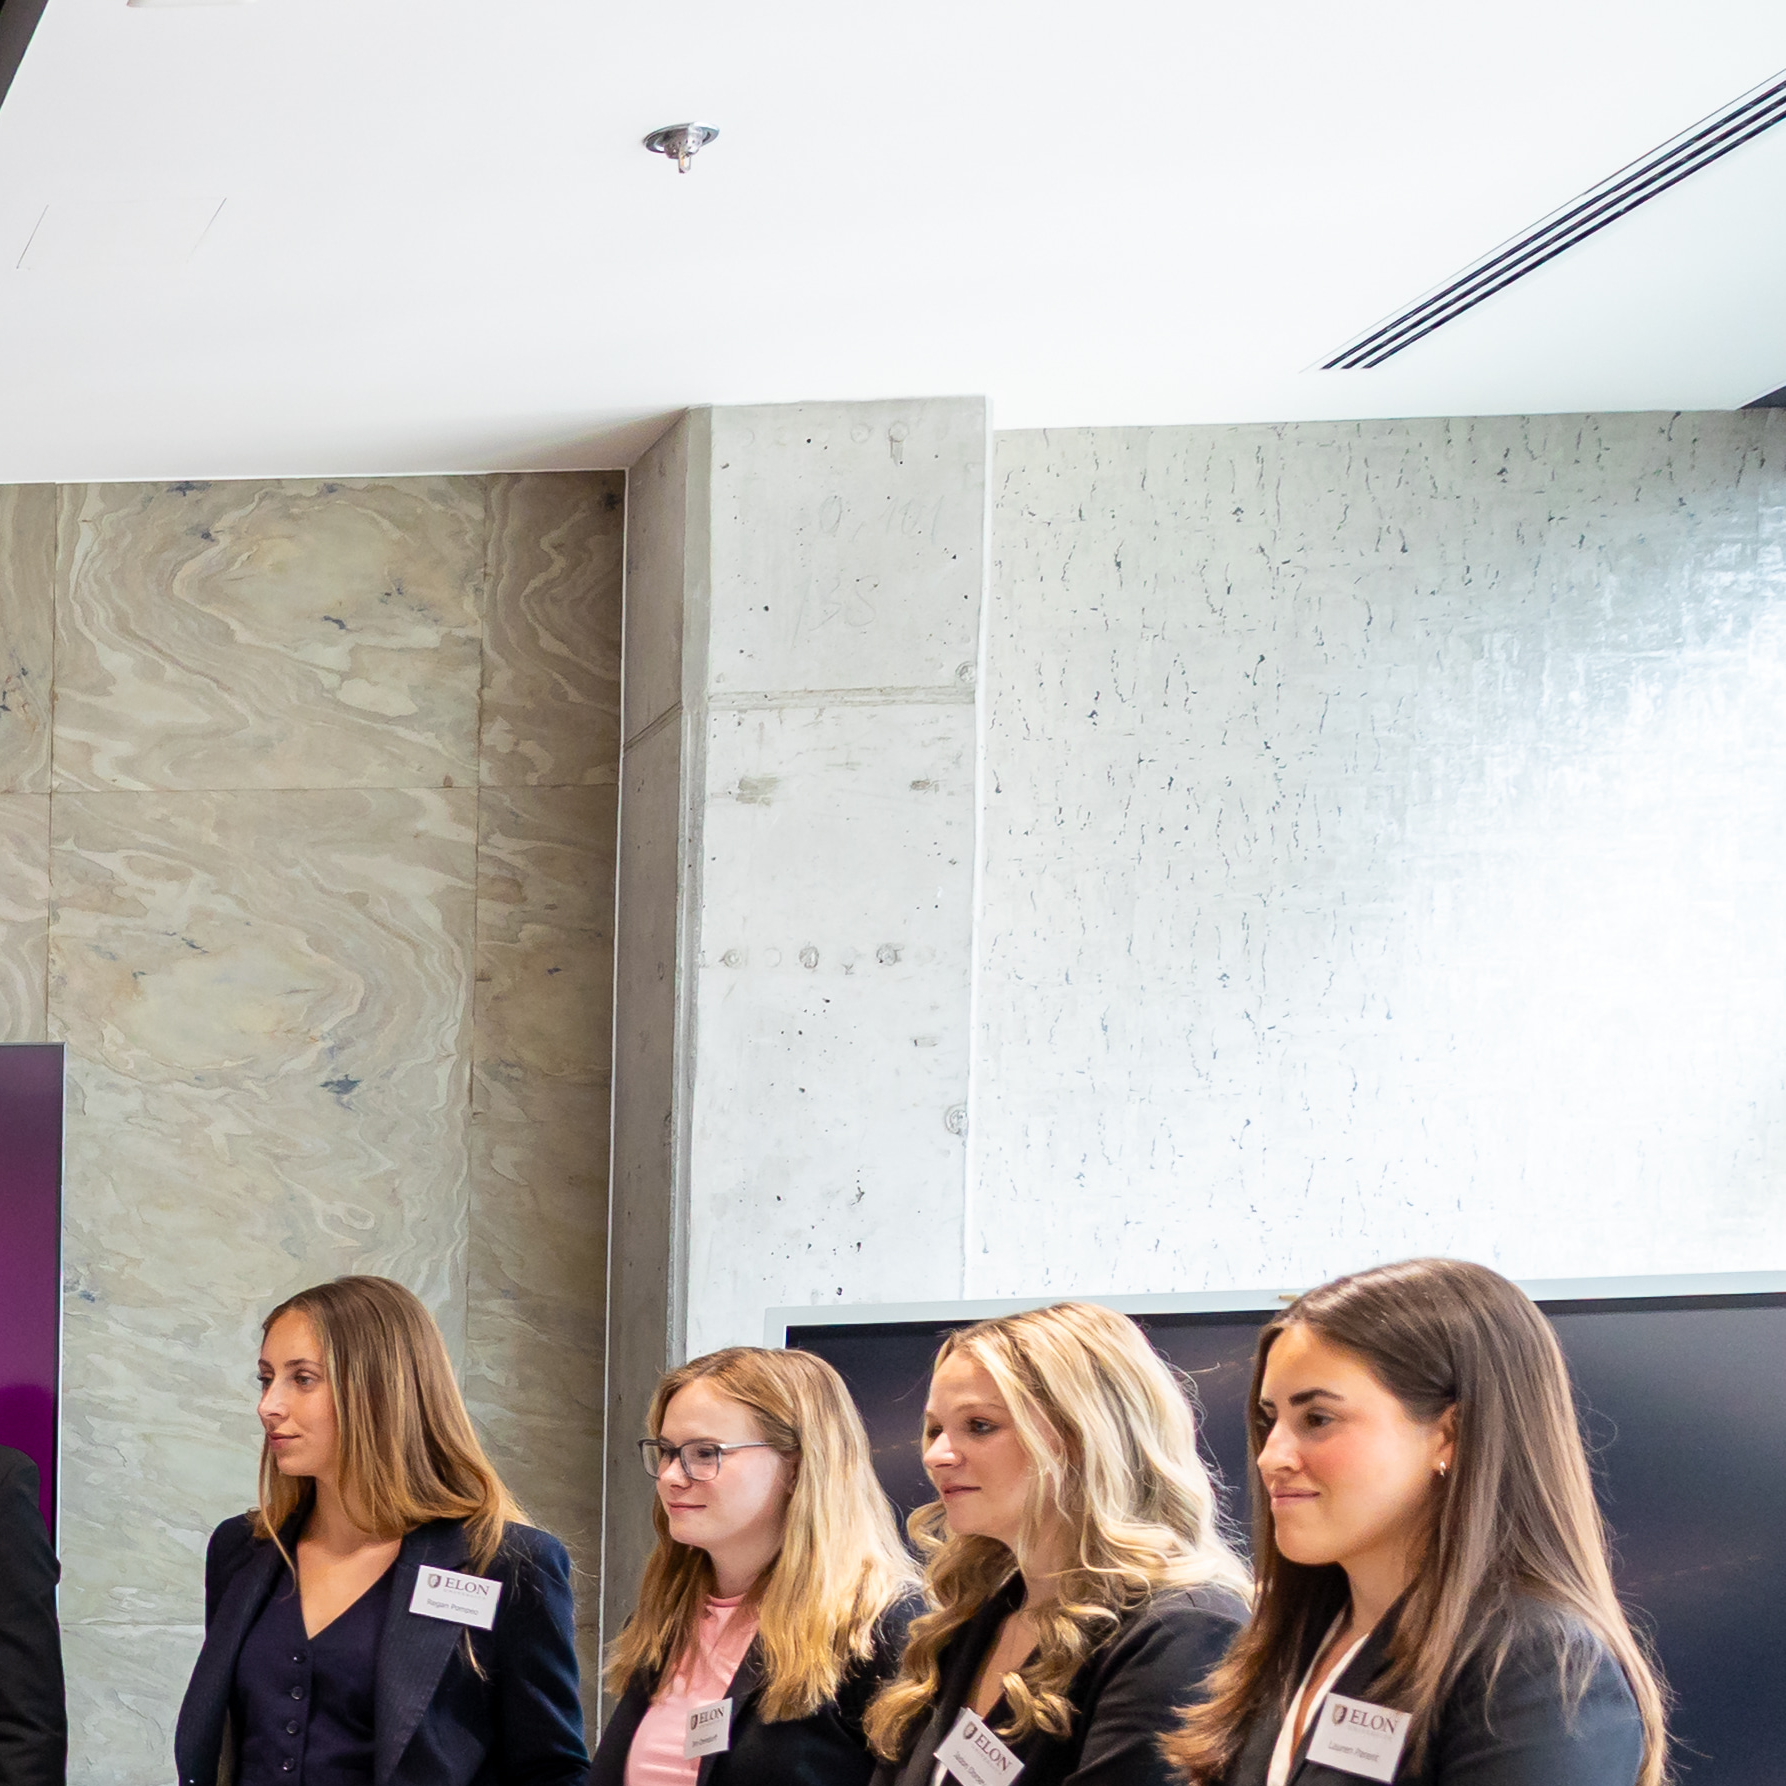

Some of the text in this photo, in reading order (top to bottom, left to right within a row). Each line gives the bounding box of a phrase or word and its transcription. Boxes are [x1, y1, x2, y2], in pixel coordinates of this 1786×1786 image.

[444, 1577, 490, 1596] ELON
[699, 1706, 725, 1724] ELON
[1349, 1708, 1398, 1734] ELON
[974, 1734, 1013, 1771] ELON
